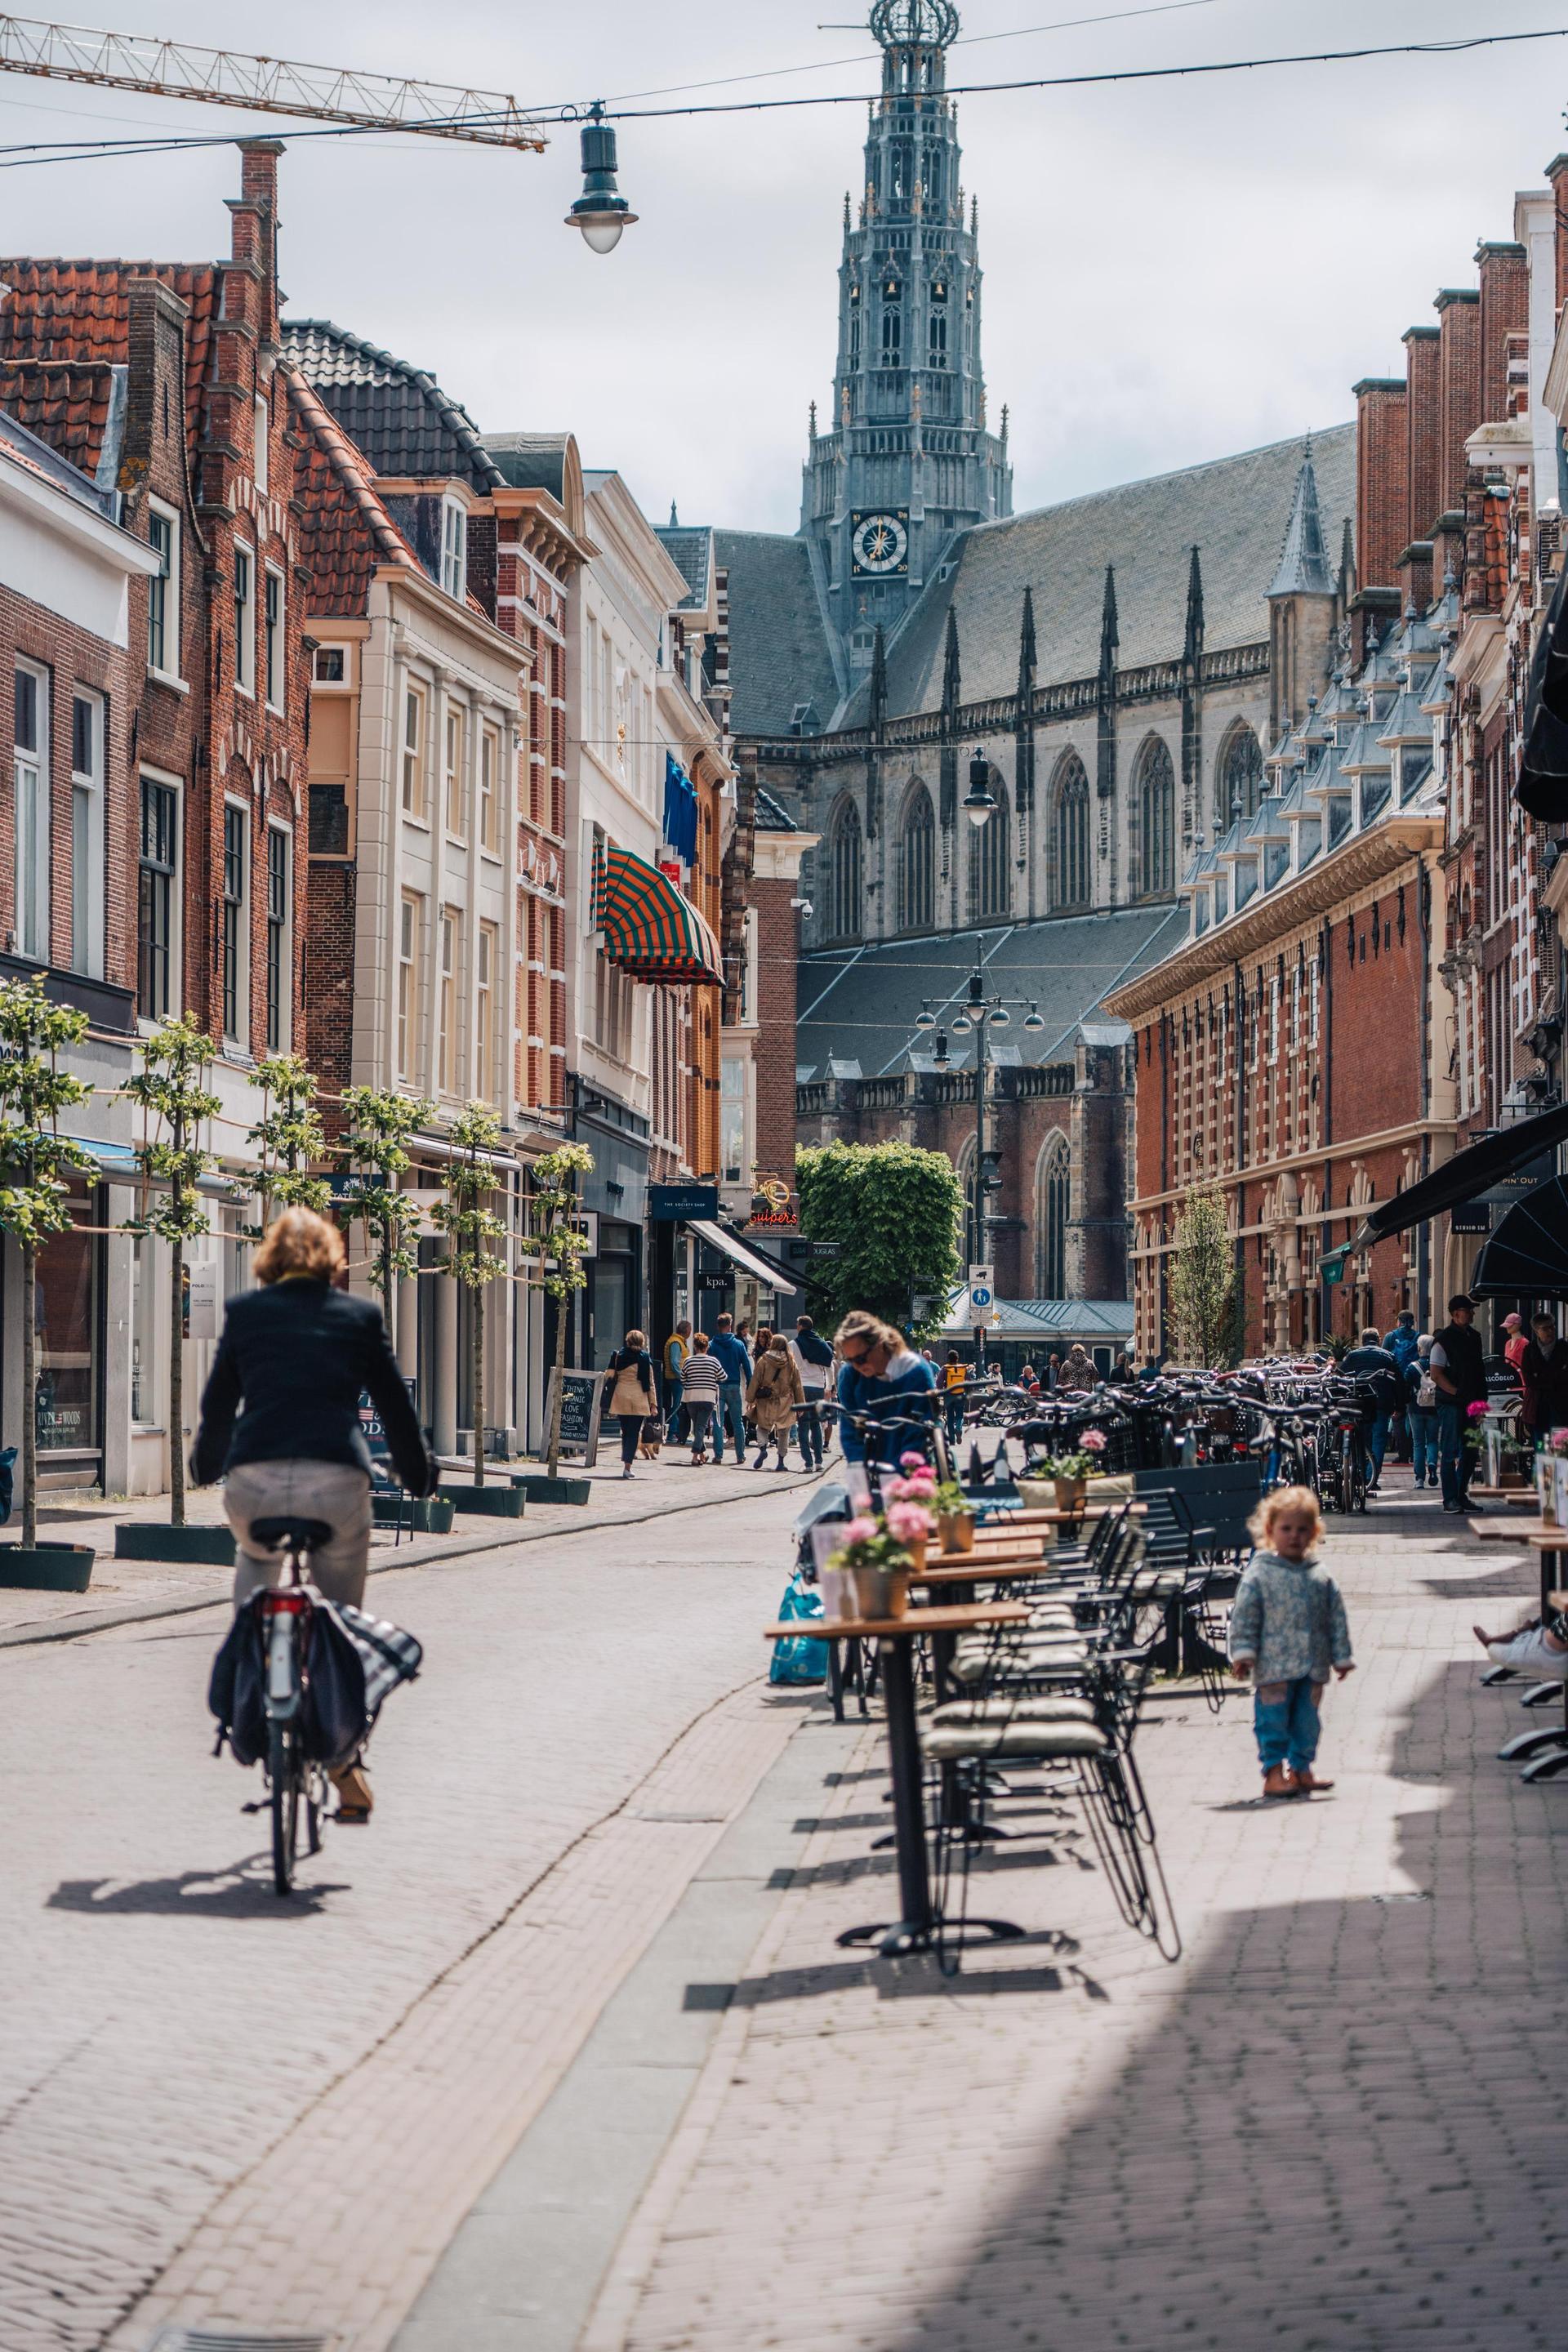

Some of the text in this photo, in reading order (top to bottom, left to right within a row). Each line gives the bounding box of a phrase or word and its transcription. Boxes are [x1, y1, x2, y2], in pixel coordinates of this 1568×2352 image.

[706, 1276, 728, 1289] kpa.
[567, 1385, 585, 1393] THINK
[564, 1405, 580, 1413] LOVE
[62, 1410, 81, 1425] WOODS
